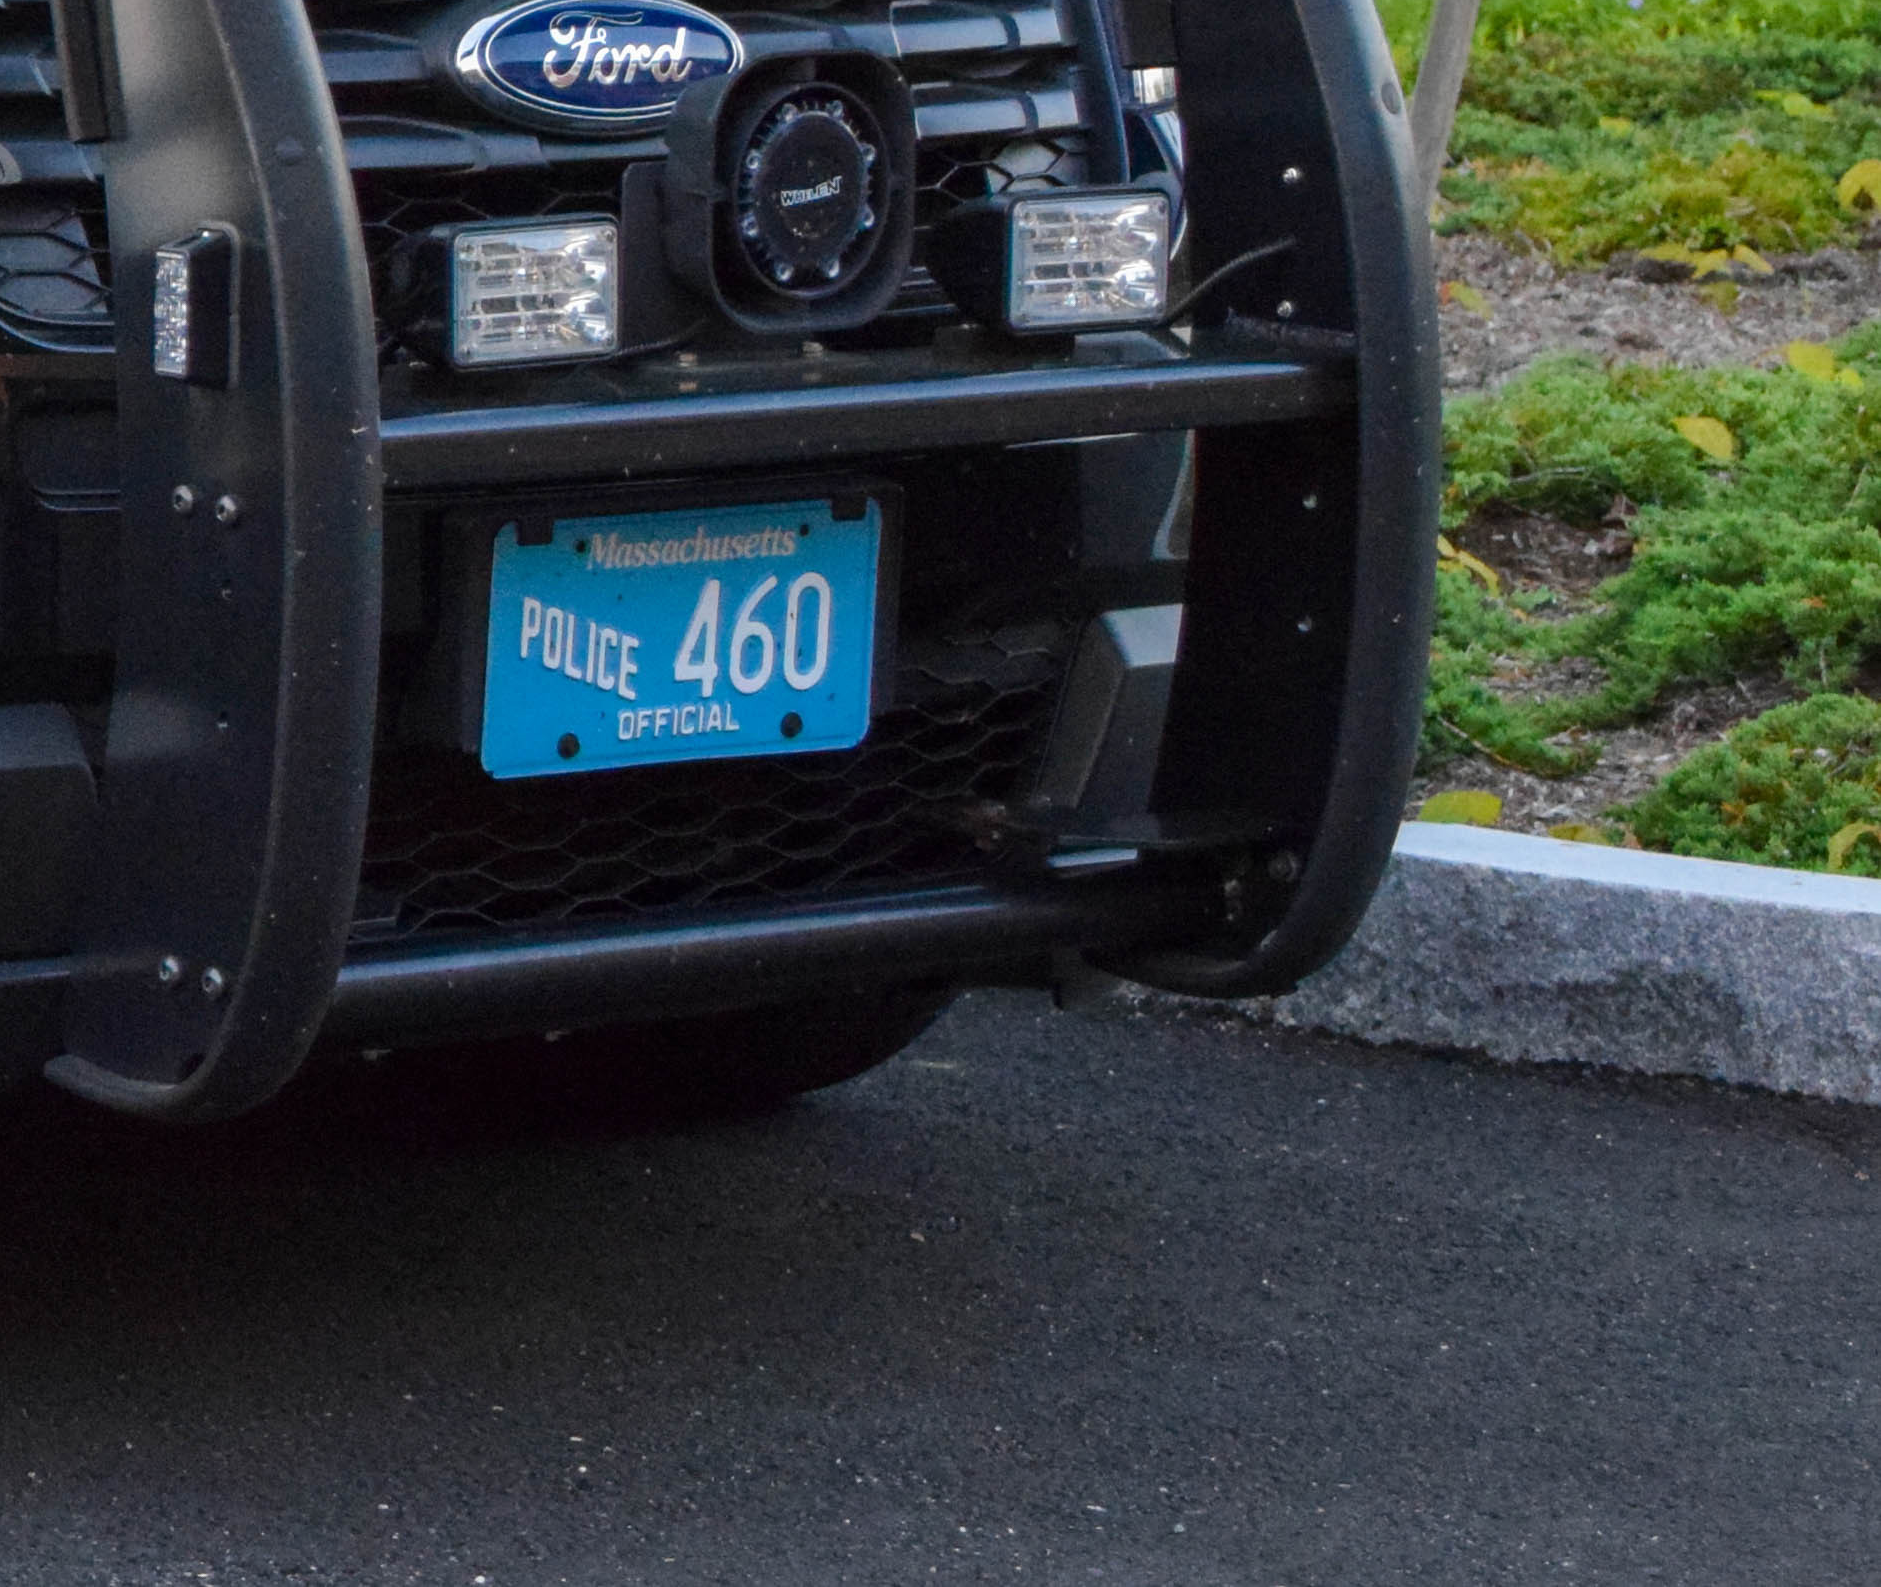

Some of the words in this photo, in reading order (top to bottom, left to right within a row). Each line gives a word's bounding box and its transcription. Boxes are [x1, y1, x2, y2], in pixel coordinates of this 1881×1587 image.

[543, 11, 692, 88] Ford
[586, 525, 798, 571] Massachusetts
[520, 596, 640, 701] POLICE
[673, 572, 832, 699] 460
[618, 702, 740, 741] OFFICIAL
